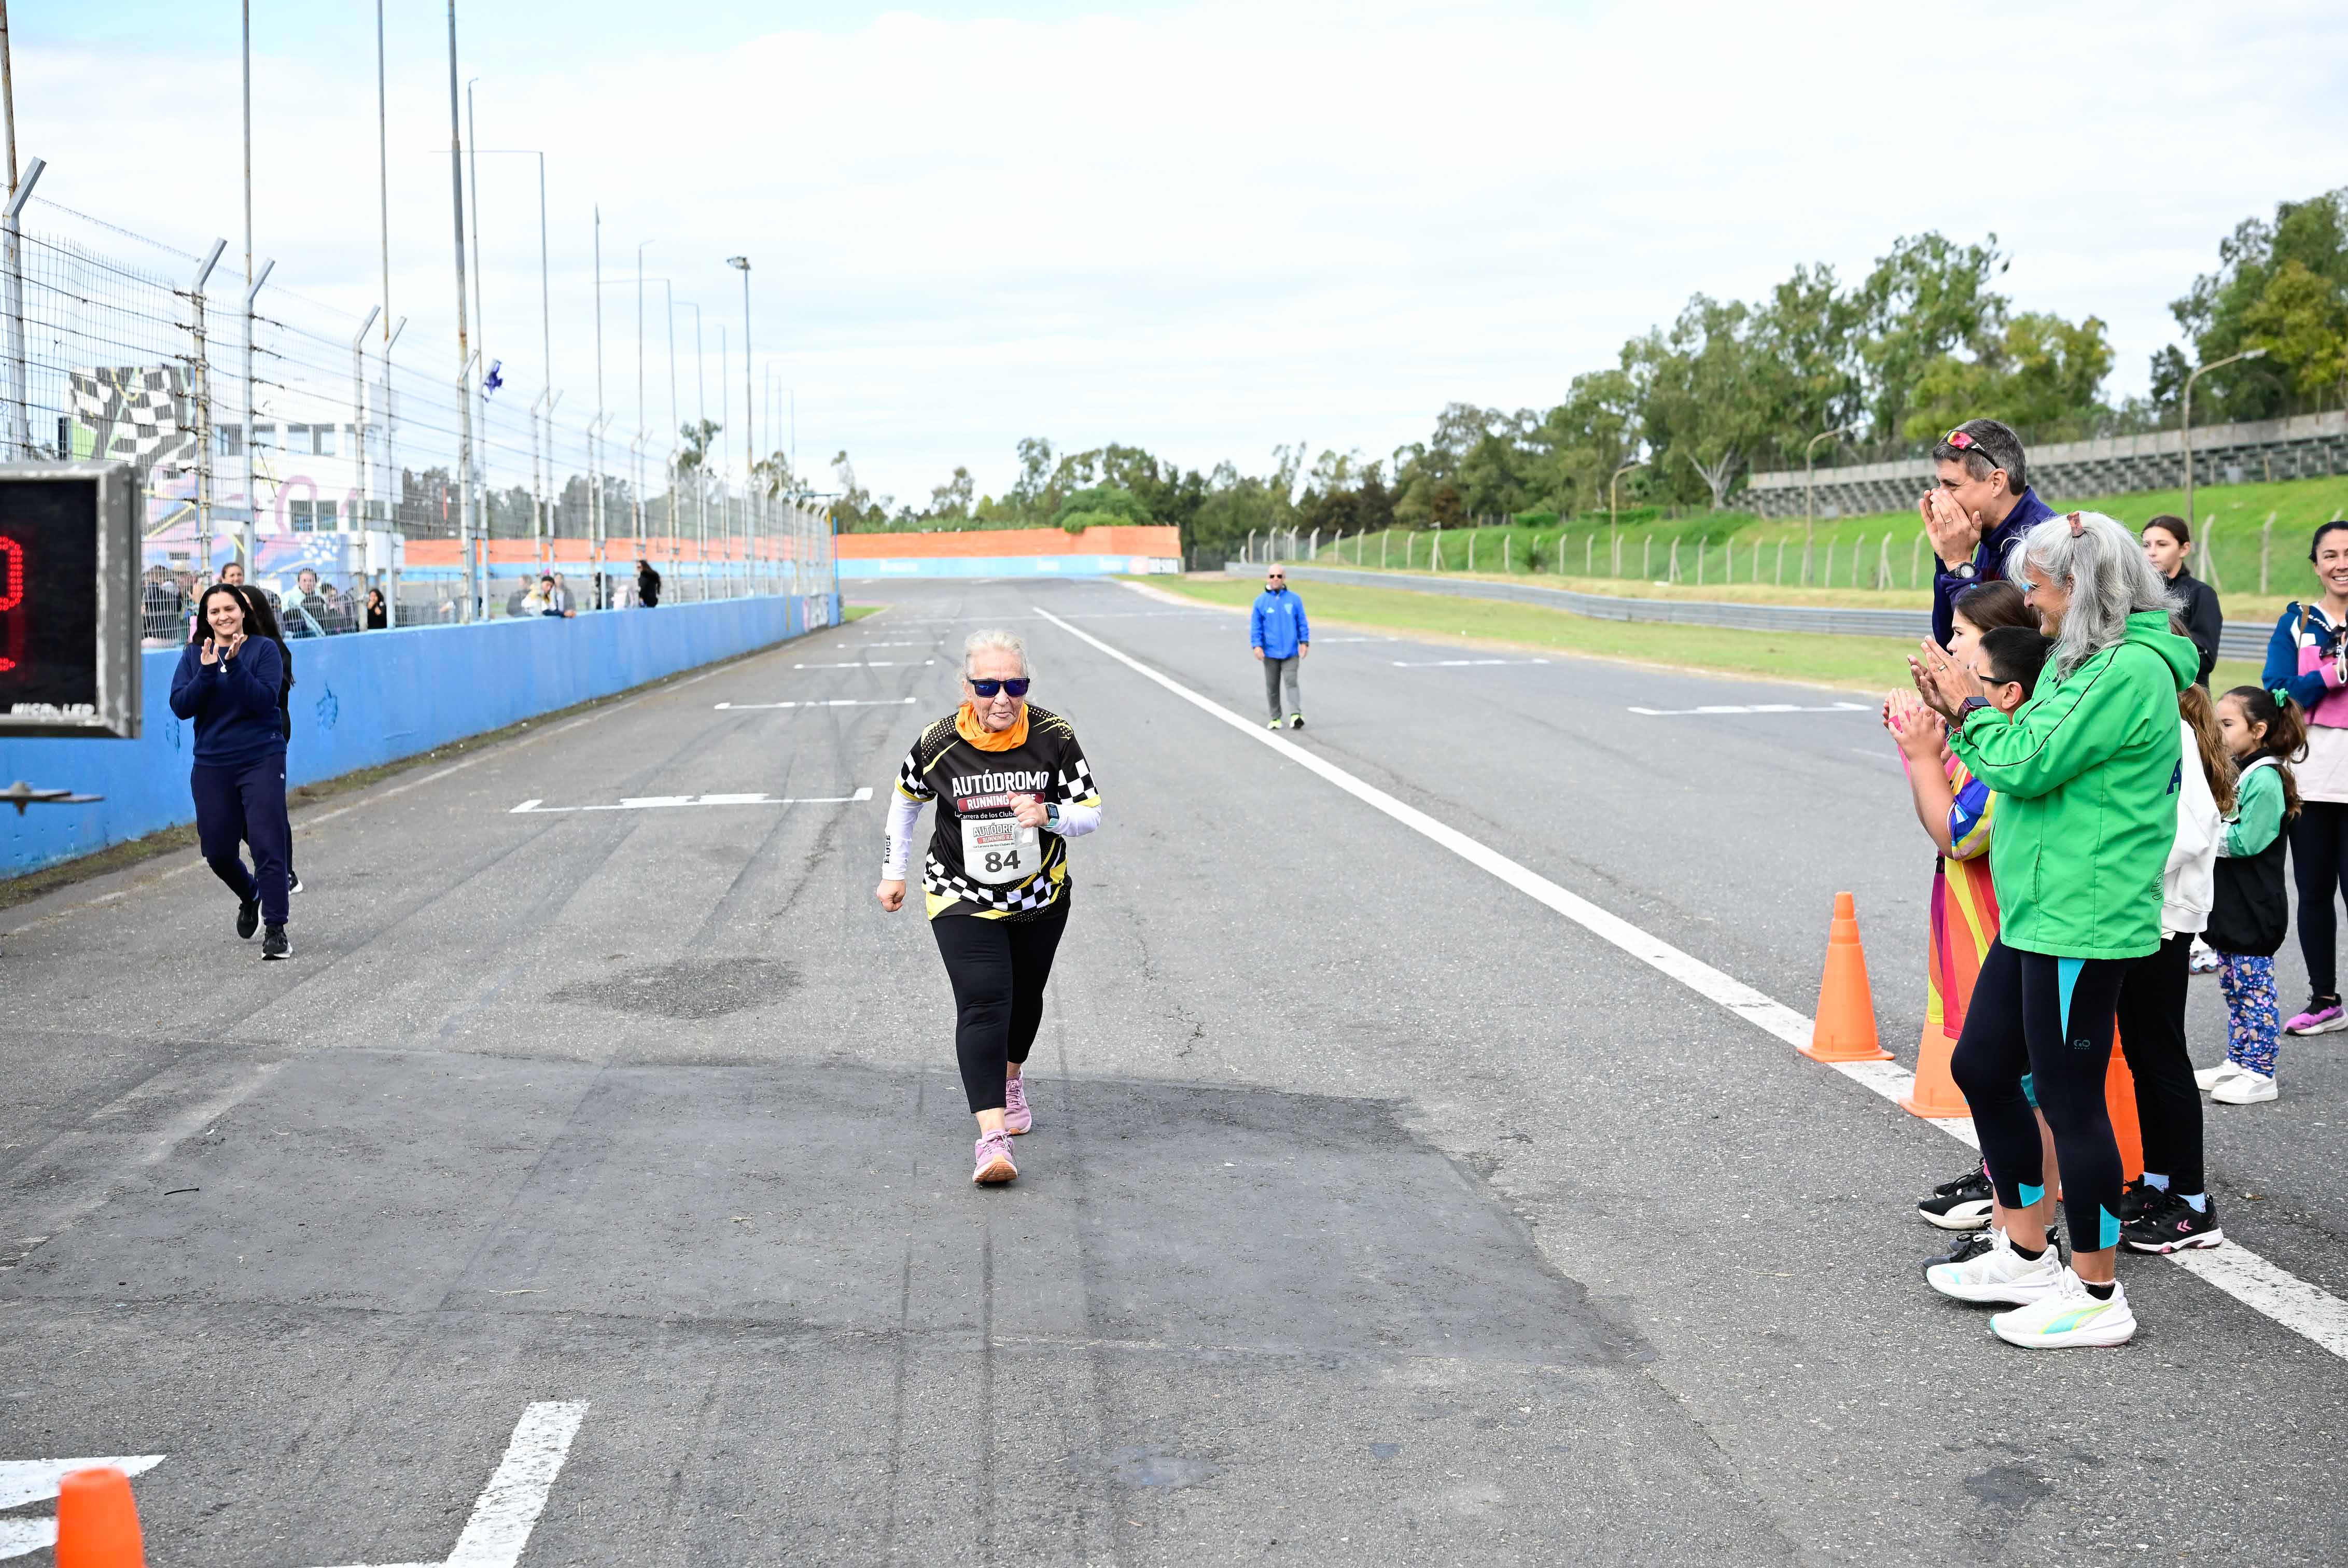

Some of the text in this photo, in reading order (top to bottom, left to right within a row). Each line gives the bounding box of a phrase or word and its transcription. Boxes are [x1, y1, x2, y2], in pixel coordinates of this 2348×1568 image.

[951, 769, 1049, 797] AUTÓDROMO
[967, 794, 1010, 810] RUNNING
[983, 835, 1005, 843] RUNNING
[985, 850, 1021, 873] 84
